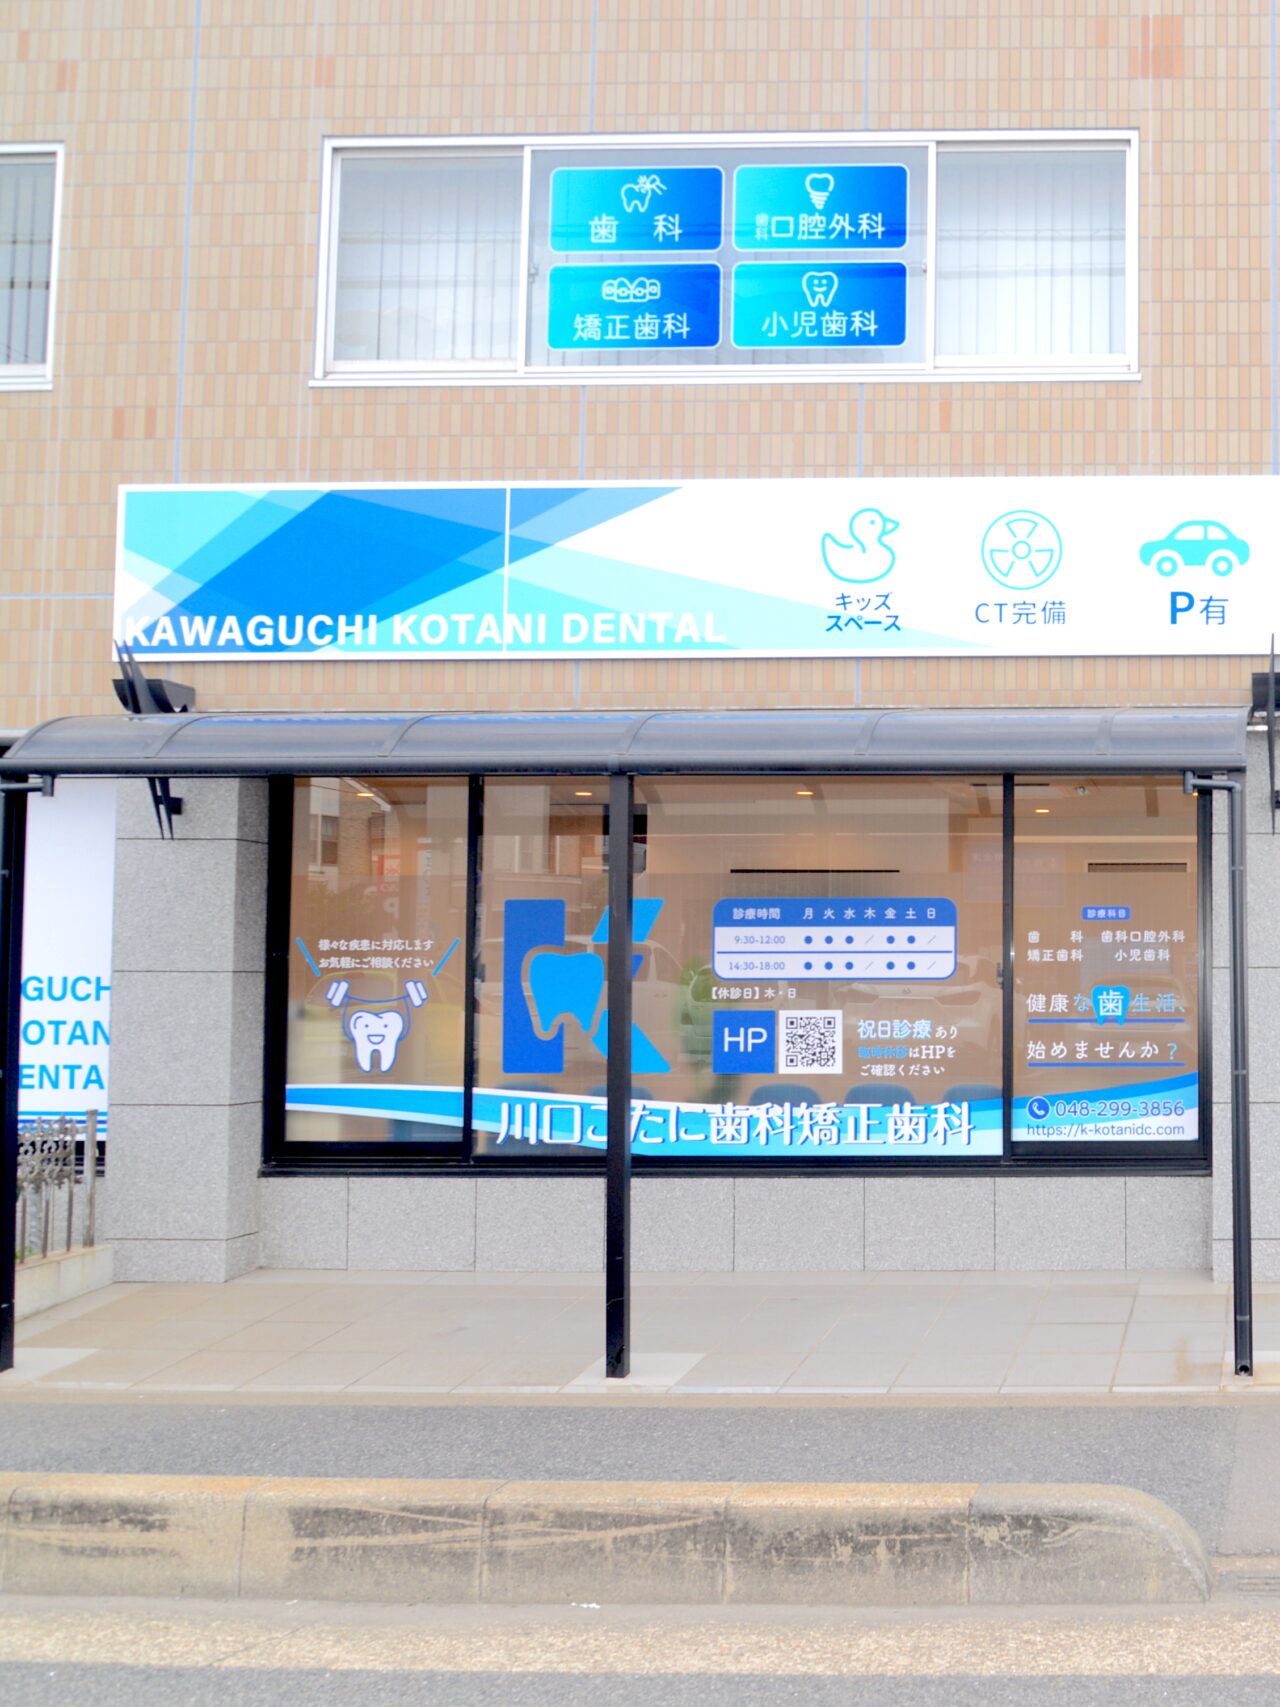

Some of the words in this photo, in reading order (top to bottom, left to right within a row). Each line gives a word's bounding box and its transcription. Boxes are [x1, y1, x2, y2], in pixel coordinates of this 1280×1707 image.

[573, 313, 691, 341] 矯正歯科
[761, 310, 879, 338] 小児歯科
[835, 592, 893, 611] キッズ
[1169, 591, 1229, 626] P有
[975, 600, 1067, 625] CT完備
[124, 614, 378, 647] KAWAGUCHI
[392, 612, 546, 645] KOTANI
[562, 611, 728, 644] DENTAL
[826, 614, 902, 632] スペース
[732, 908, 782, 920] 診療時間
[803, 907, 813, 920] 月
[823, 908, 835, 920] 火
[843, 908, 856, 919] 水
[864, 908, 876, 919] 木
[884, 907, 897, 919] 金
[905, 908, 917, 919] 土
[926, 908, 936, 919] 日
[1087, 909, 1126, 918] 診療科目
[734, 935, 786, 945] 9:30-12:00
[1101, 930, 1186, 943] 歯科口腔外科
[318, 939, 435, 951] 様々な疾患に対応します
[318, 956, 435, 968] お気軽にご相談ください
[1027, 949, 1084, 962] 矯正歯科
[1114, 949, 1171, 962] 小児歯科
[728, 961, 786, 971] 14:30-18:00
[723, 1027, 768, 1053] HP
[860, 1064, 945, 1077] ご確認ください
[1055, 1100, 1185, 1118] 048-299-3856
[1027, 1123, 1185, 1138] https://k-kotanidc.com
